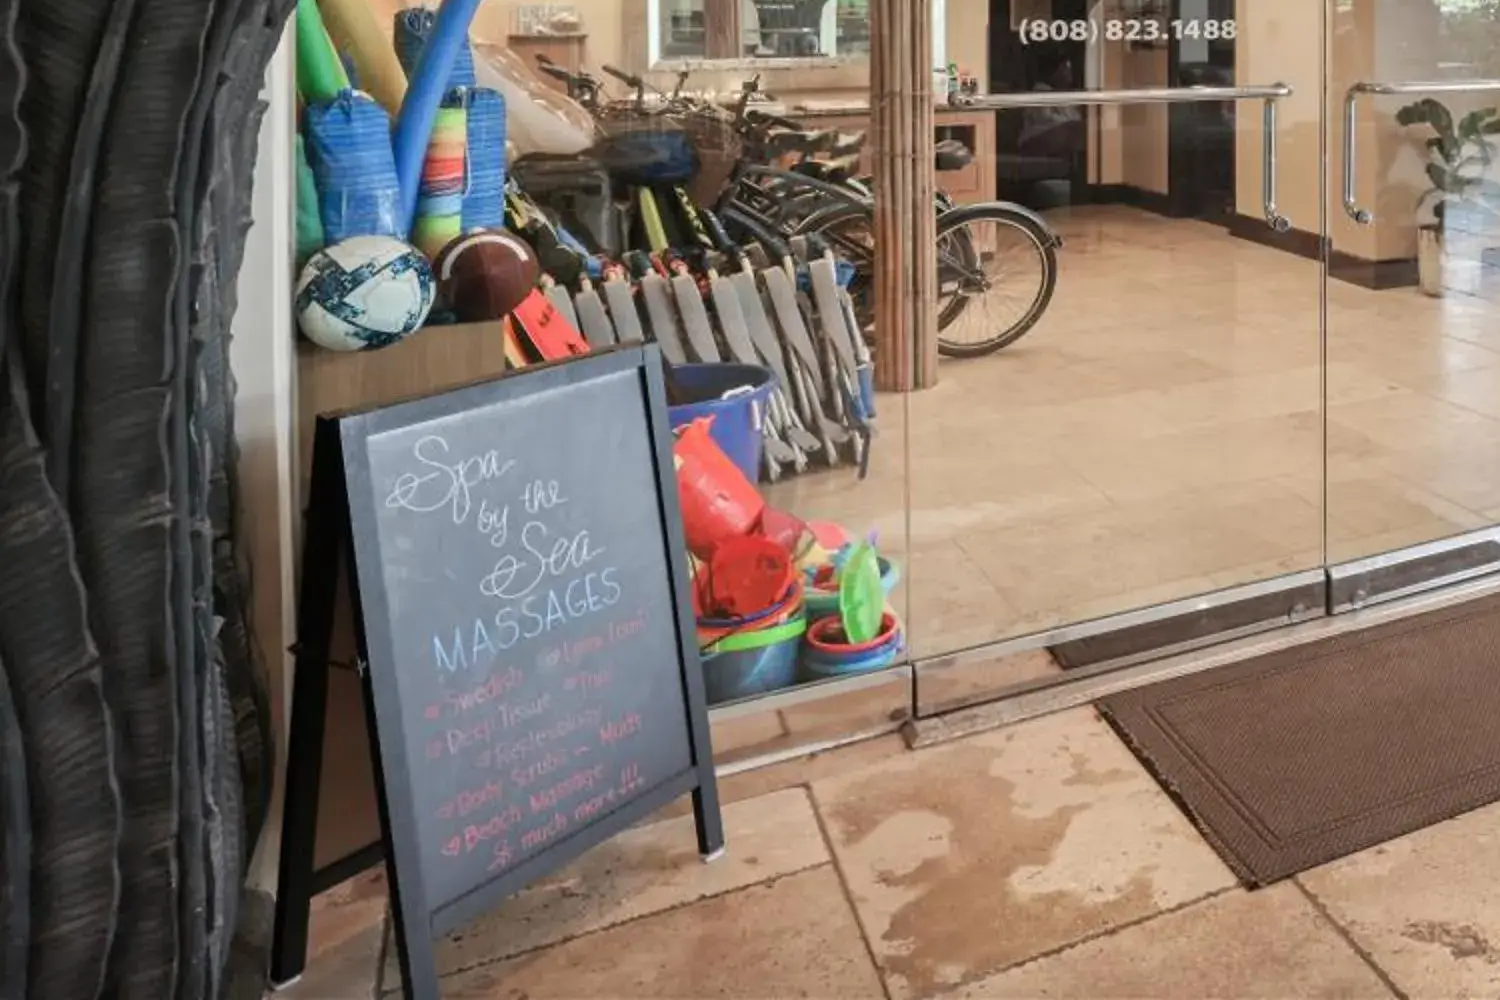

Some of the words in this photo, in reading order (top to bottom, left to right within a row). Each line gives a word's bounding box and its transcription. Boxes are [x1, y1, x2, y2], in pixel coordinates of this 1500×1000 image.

[1019, 18, 1098, 45] (808)
[1105, 18, 1238, 41] 823.1488
[386, 435, 517, 523] Spa
[478, 500, 509, 547] by
[520, 480, 568, 513] the
[480, 521, 605, 598] Sea
[433, 567, 621, 672] MASSAGES
